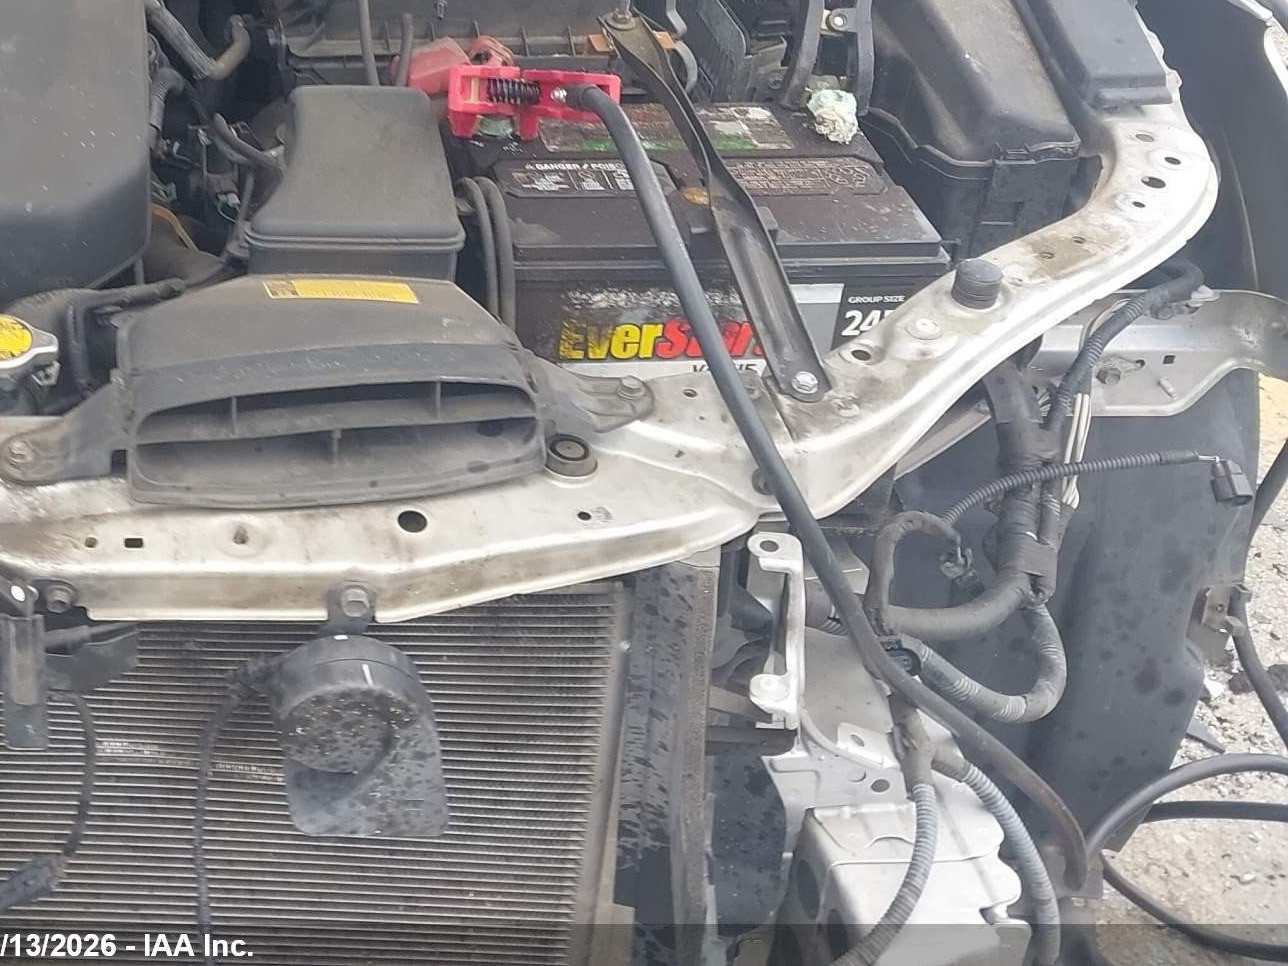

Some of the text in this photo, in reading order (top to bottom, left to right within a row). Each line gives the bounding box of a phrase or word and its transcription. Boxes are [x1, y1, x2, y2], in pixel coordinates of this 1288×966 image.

[535, 162, 581, 171] DANGER
[847, 295, 906, 304] GROUP SIZE
